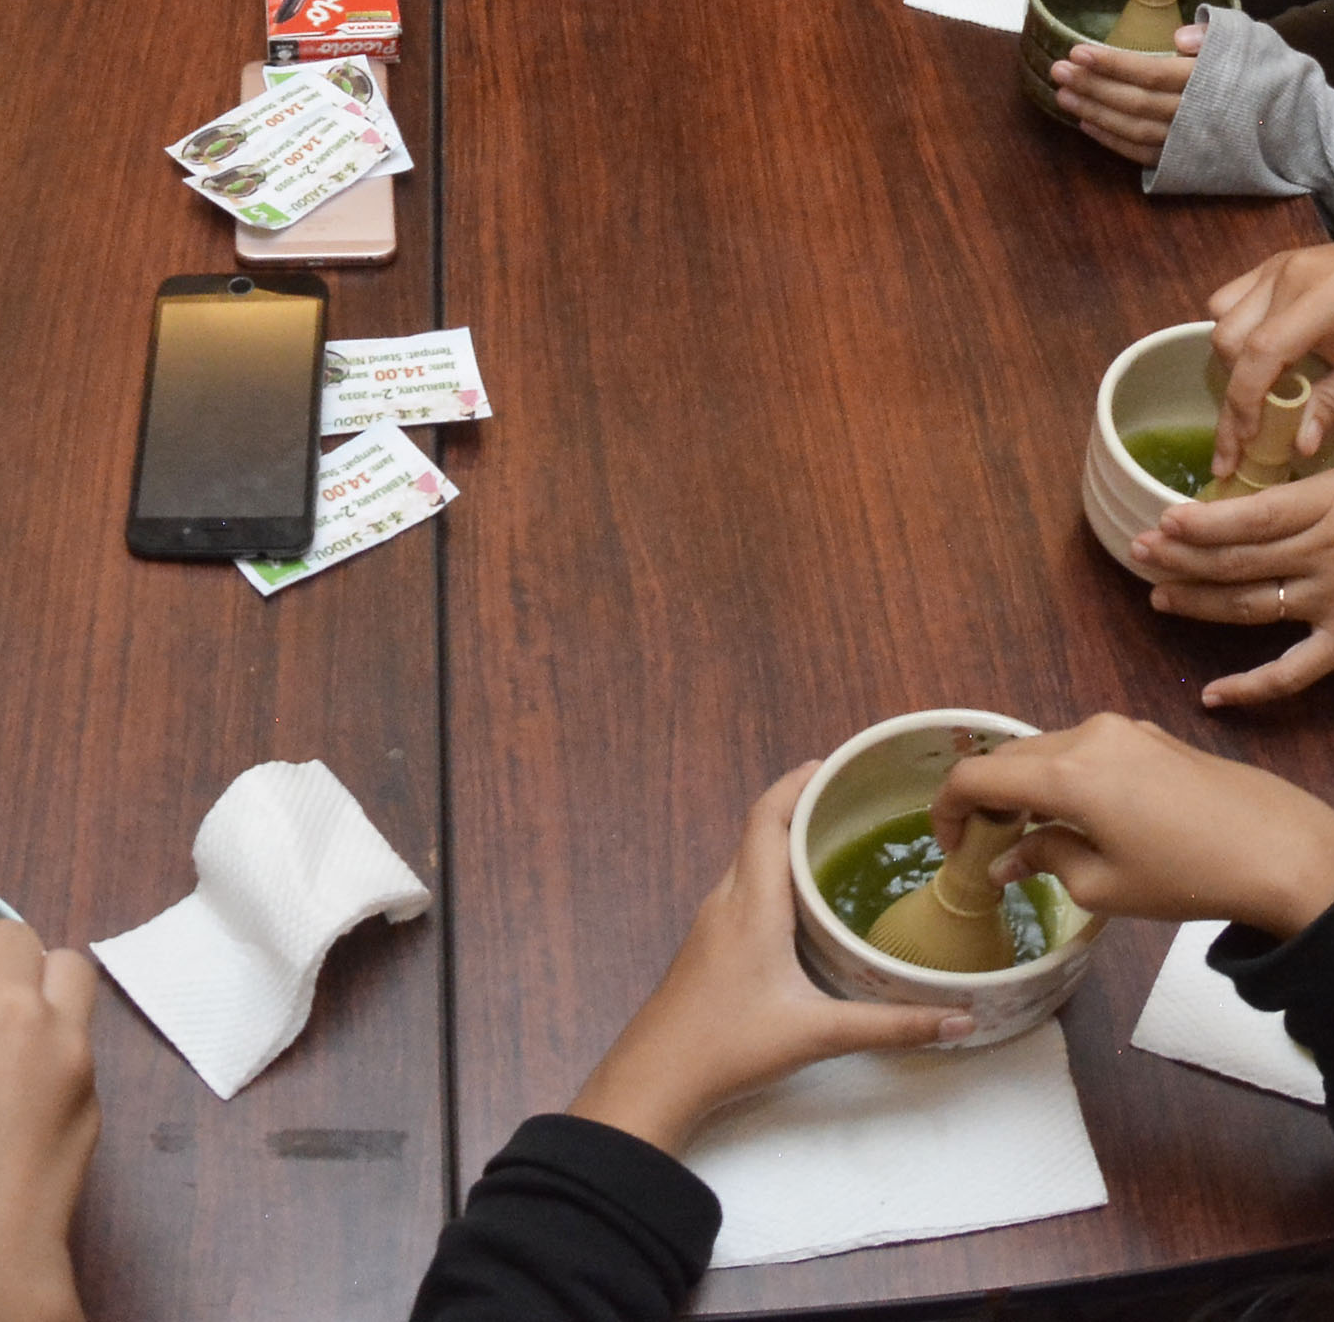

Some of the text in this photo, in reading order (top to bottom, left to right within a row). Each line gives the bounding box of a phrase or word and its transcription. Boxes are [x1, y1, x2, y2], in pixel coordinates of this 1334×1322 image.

[317, 39, 398, 56] Piccolo
[264, 101, 305, 128] 14.00
[283, 135, 322, 168] 14.00
[288, 183, 326, 212] SADOU
[368, 352, 402, 366] Stand
[404, 346, 453, 360] Tempat:
[374, 365, 425, 382] 14.00
[338, 391, 368, 402] 2019
[395, 381, 460, 396] FEBRUARY,
[339, 442, 384, 473] Tempat:
[322, 471, 371, 503] 14.00
[313, 531, 363, 561] SADOU
